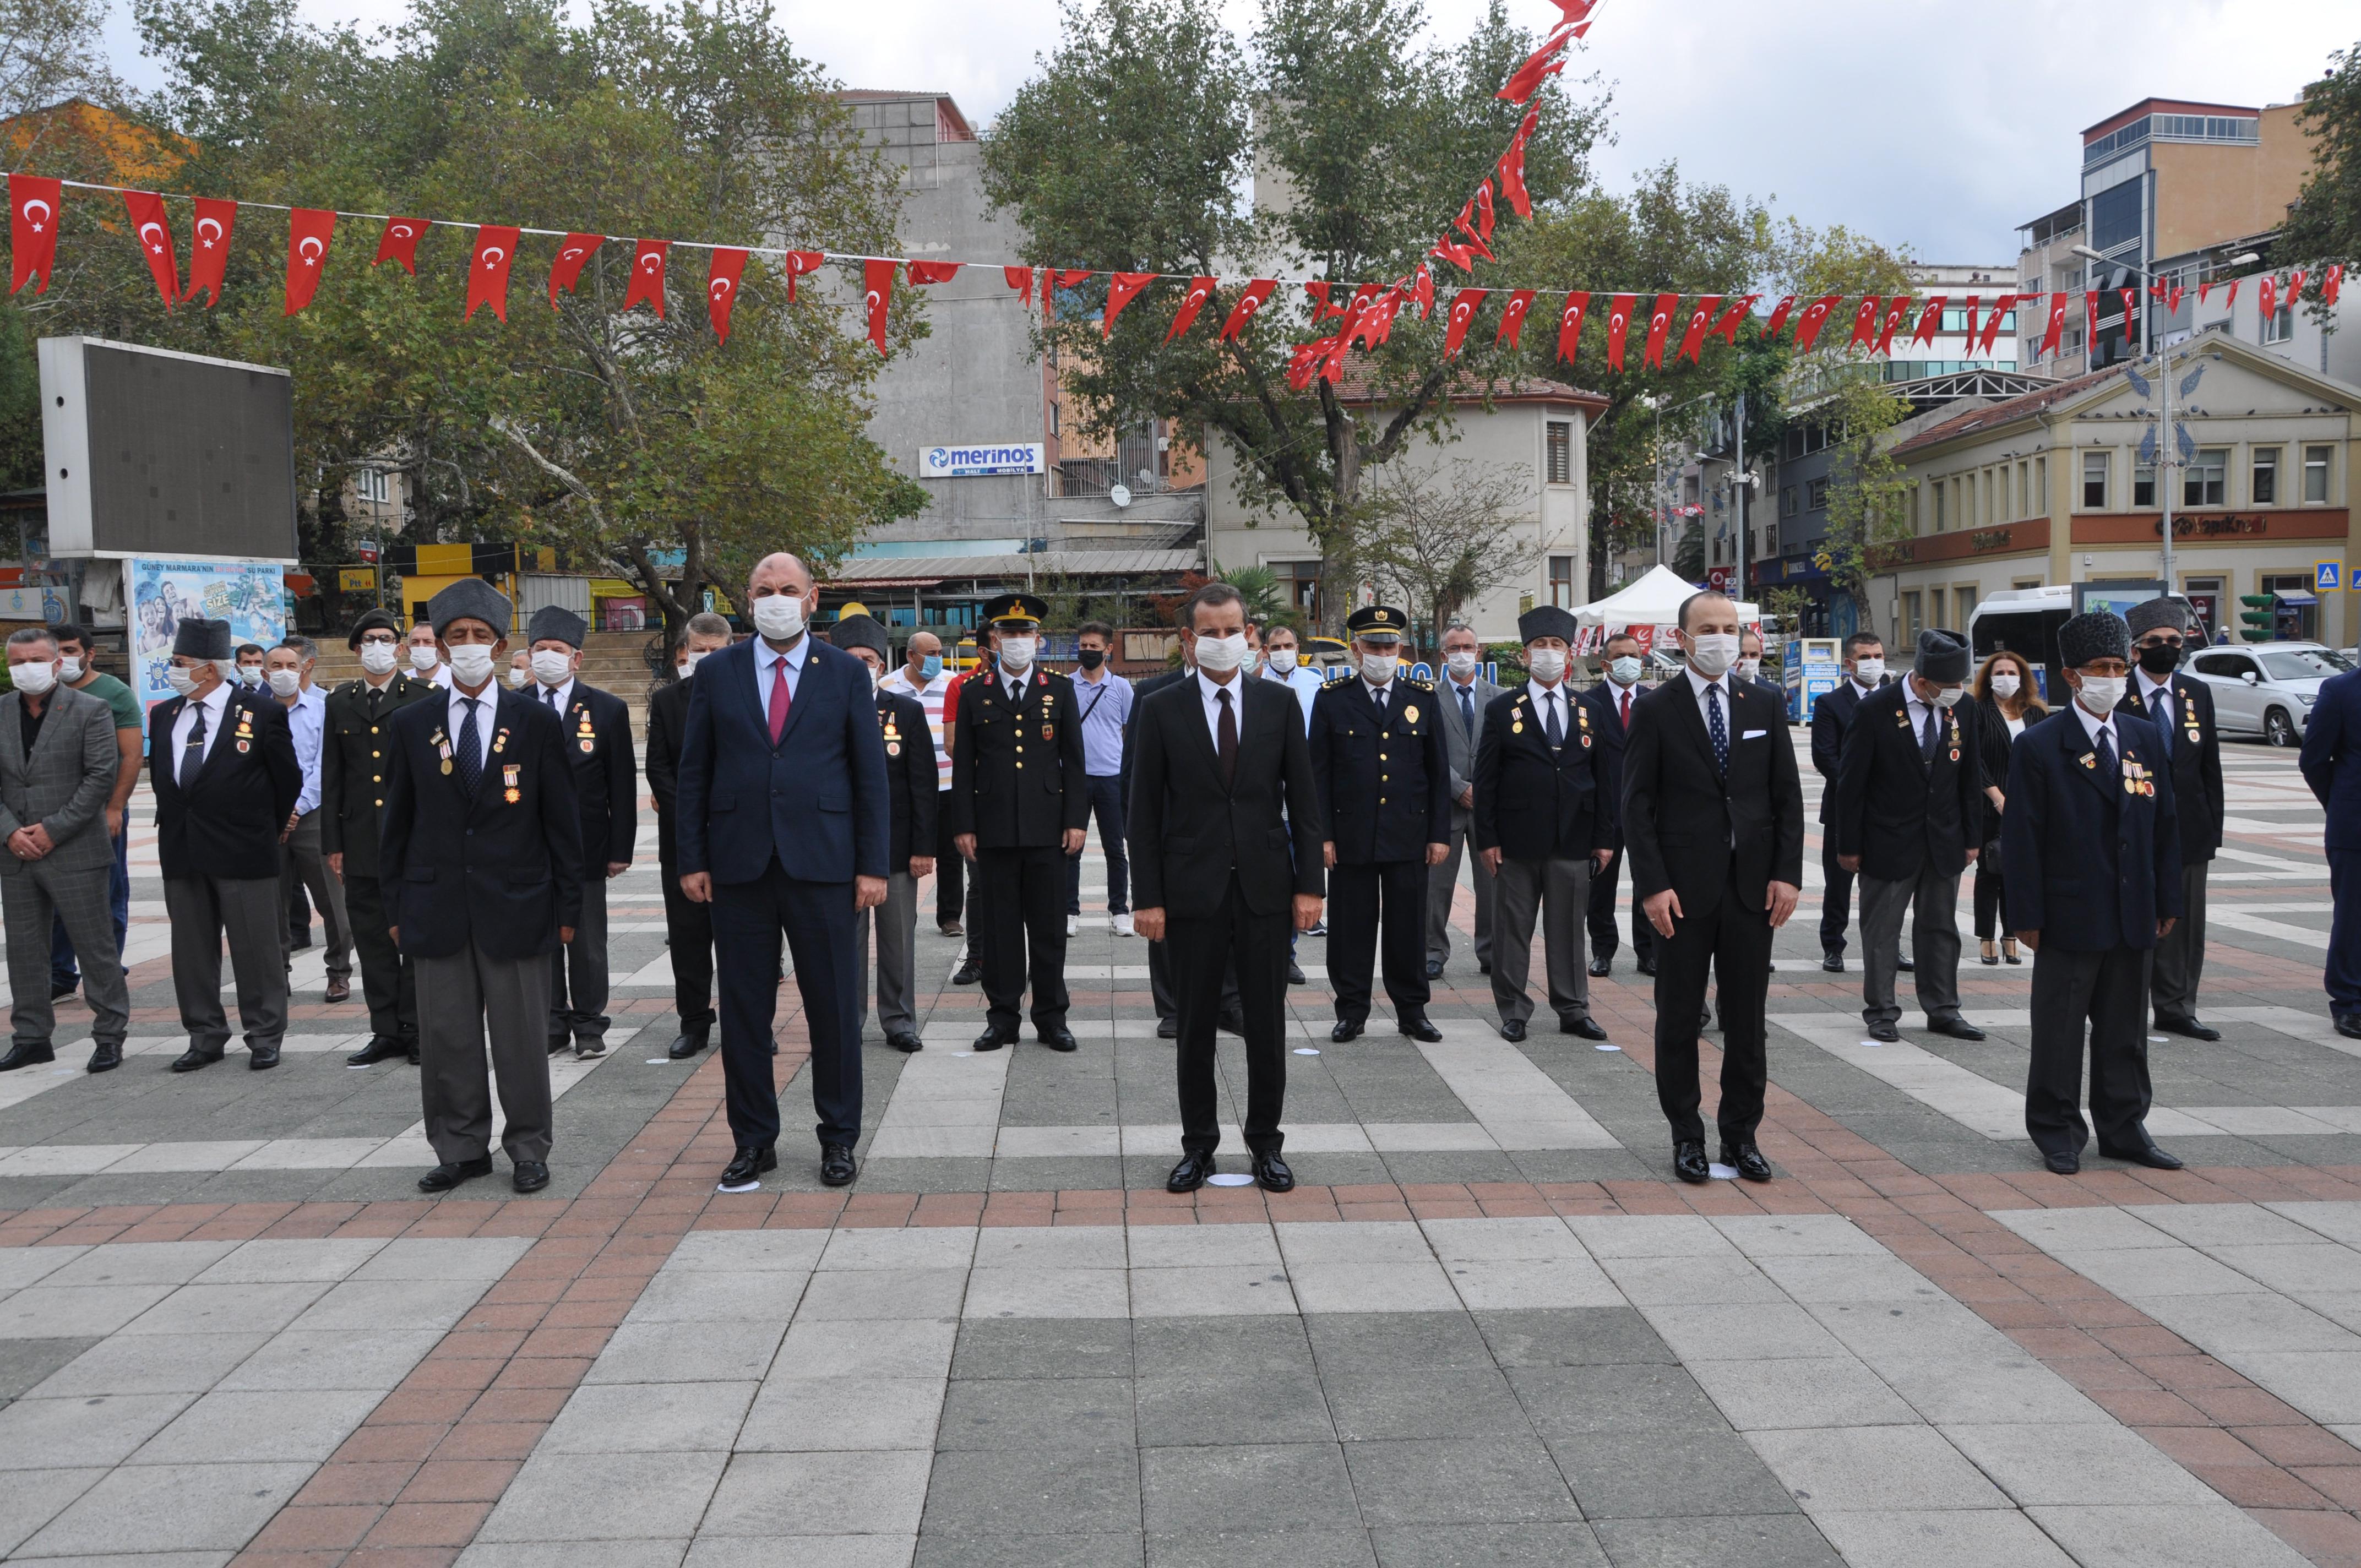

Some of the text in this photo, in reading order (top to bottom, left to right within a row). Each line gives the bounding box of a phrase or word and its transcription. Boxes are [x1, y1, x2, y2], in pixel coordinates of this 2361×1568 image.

[951, 448, 1033, 465] merinos
[142, 562, 165, 571] GÜNEY
[350, 579, 361, 587] Ptt
